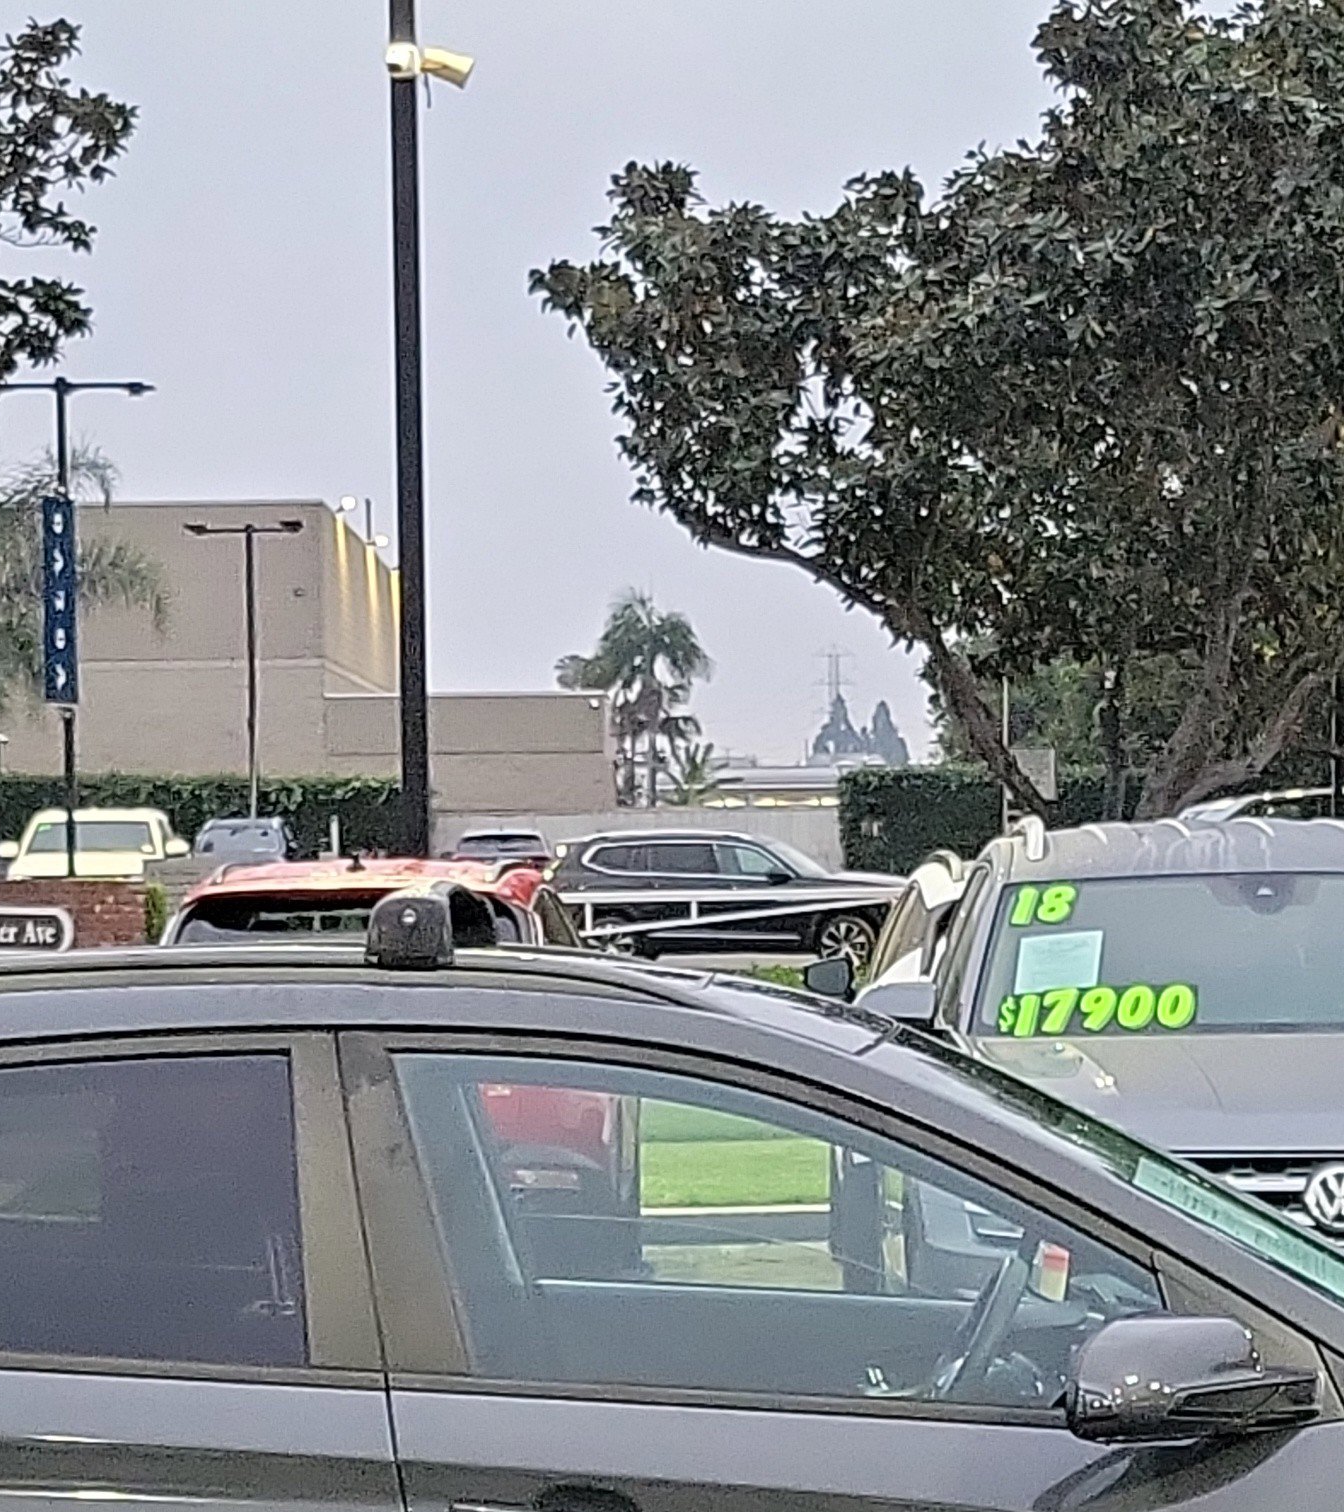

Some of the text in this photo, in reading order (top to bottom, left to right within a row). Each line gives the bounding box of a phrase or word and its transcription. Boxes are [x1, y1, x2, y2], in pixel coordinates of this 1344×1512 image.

[1011, 885, 1077, 926] 18
[23, 921, 57, 944] Ave
[998, 984, 1197, 1037] $17900
